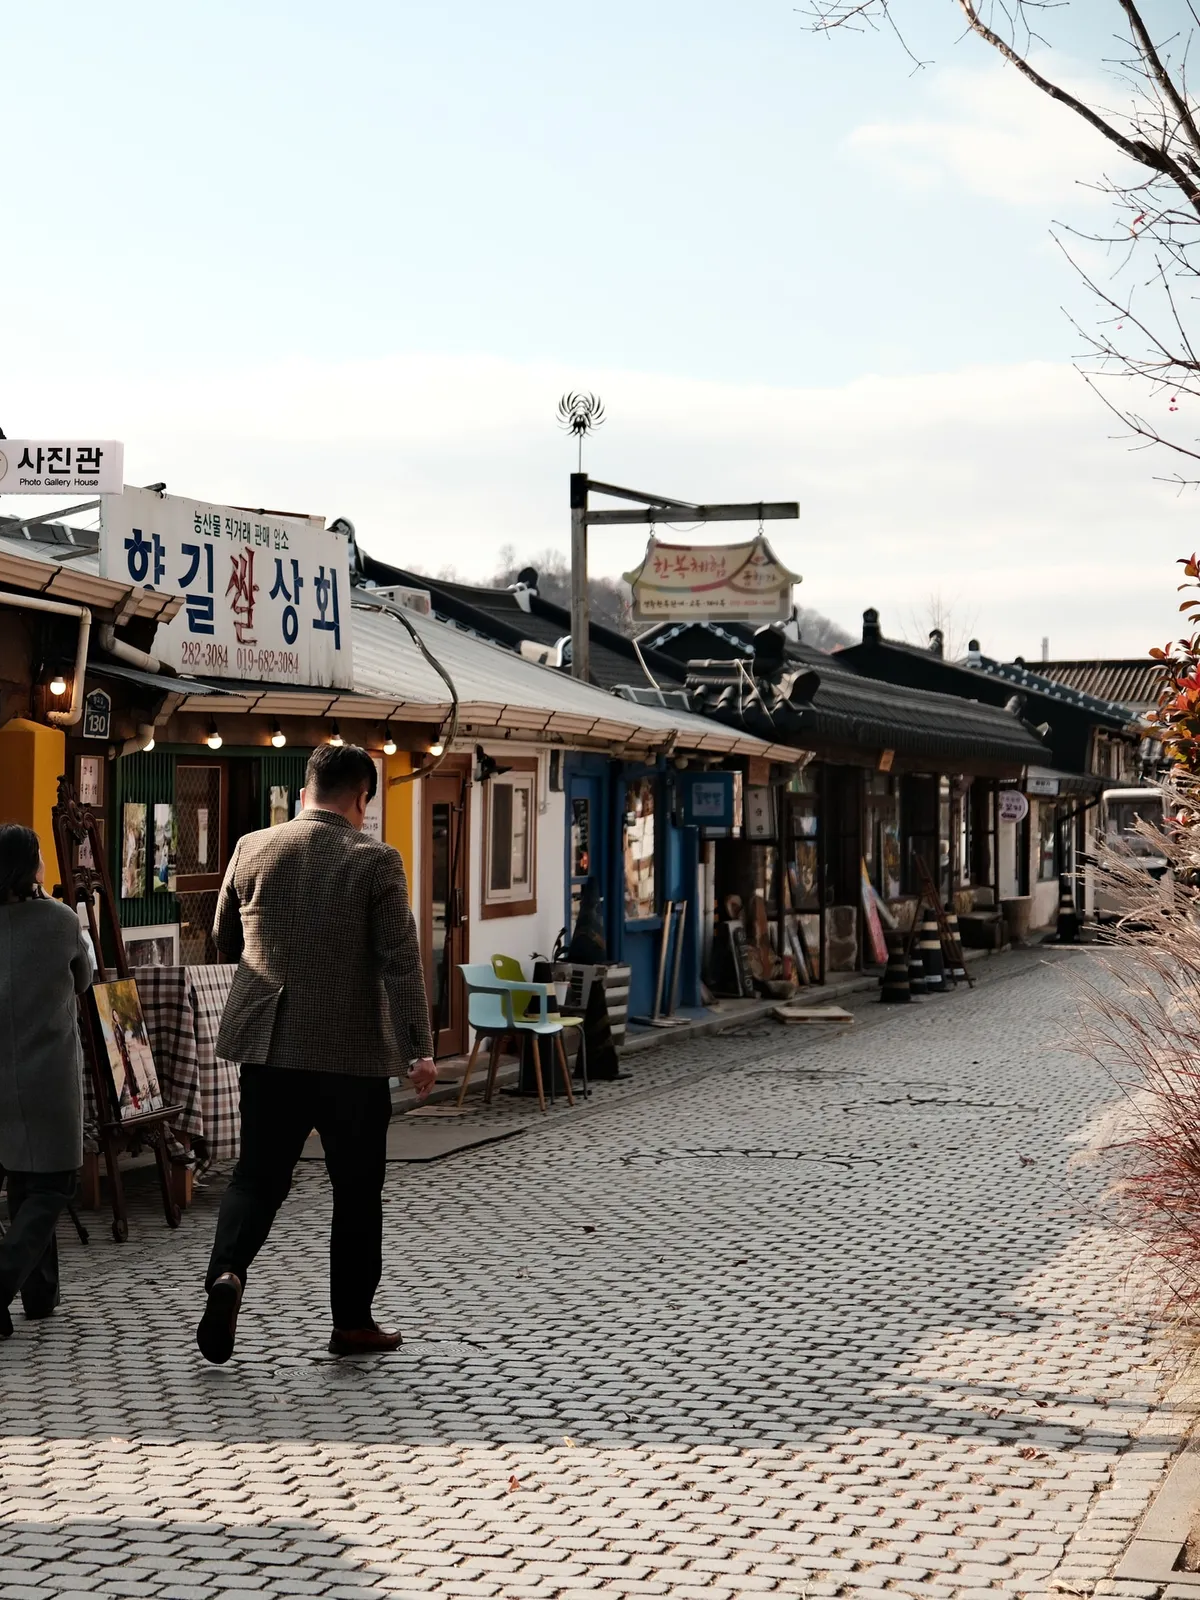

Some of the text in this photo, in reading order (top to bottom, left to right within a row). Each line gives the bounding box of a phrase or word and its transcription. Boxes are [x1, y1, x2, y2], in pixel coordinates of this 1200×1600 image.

[17, 447, 103, 474] 사진관
[19, 478, 99, 487] Photo Gallery House
[194, 511, 289, 550] 농산물 직거래 판매 업소
[181, 641, 299, 674] 282-3084 019-682-3084
[89, 714, 106, 733] 130
